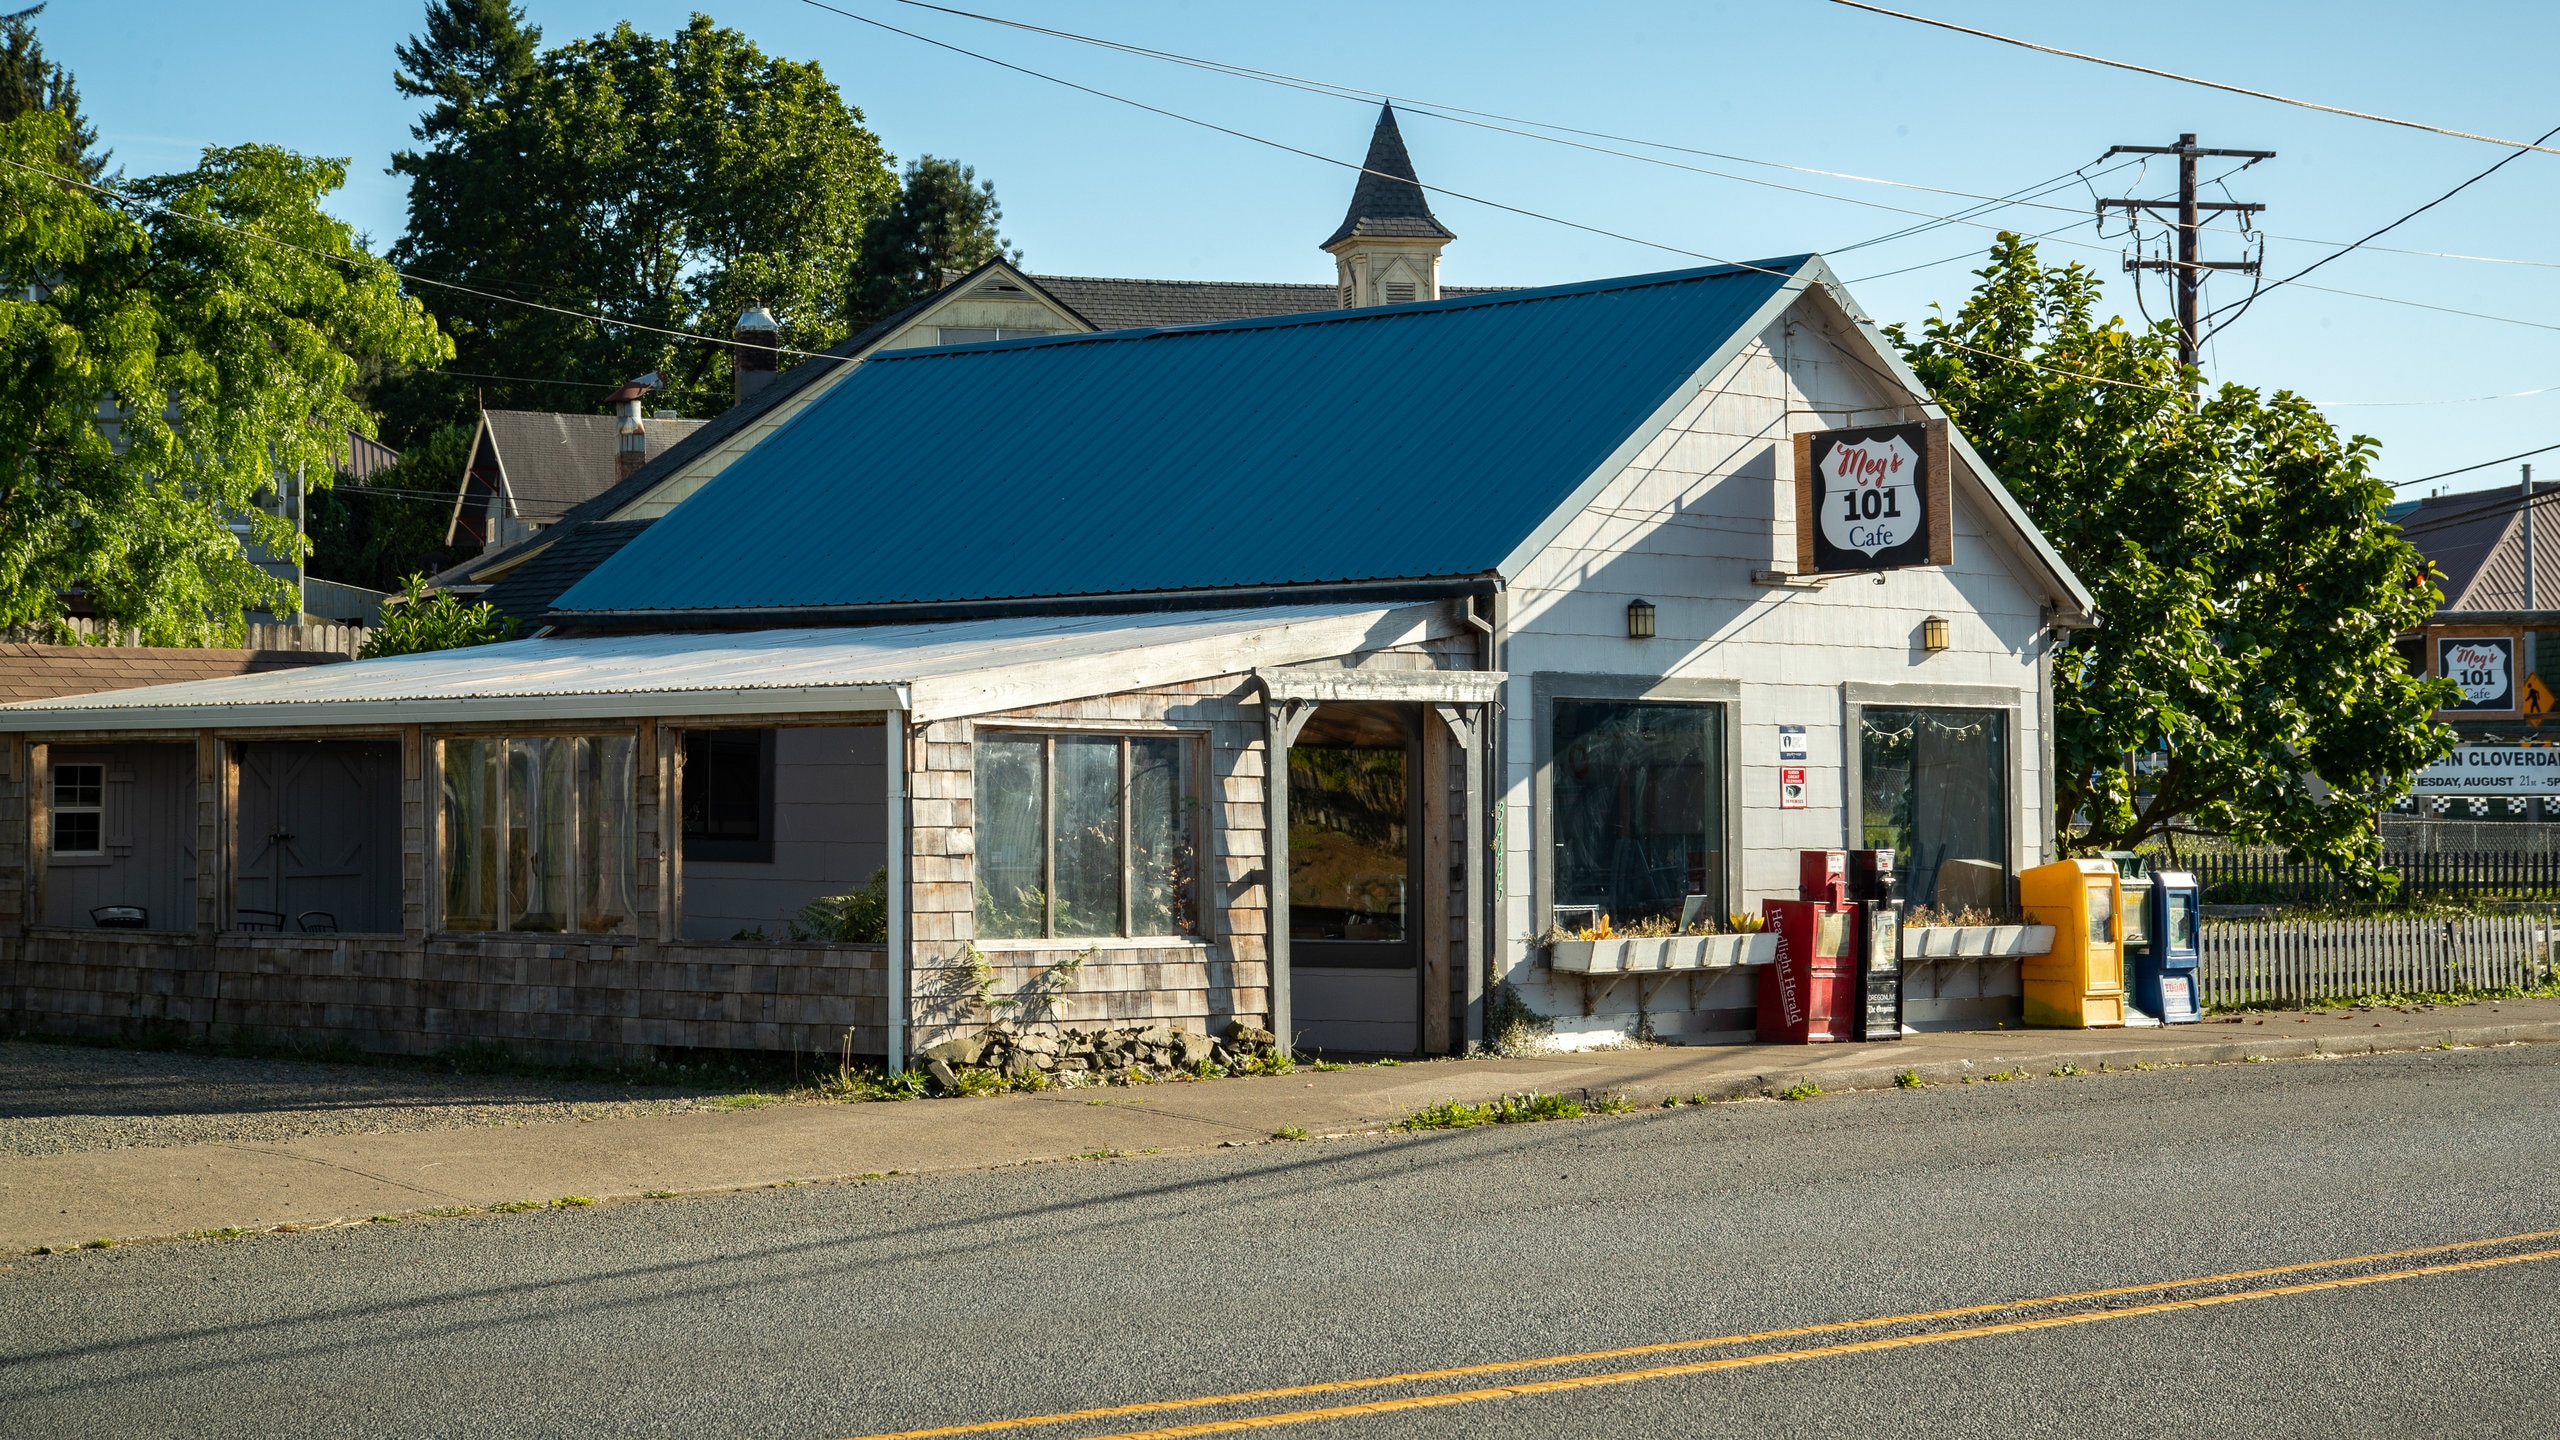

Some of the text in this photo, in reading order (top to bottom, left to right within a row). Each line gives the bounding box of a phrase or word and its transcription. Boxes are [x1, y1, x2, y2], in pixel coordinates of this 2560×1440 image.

[1837, 444, 1904, 488] Meg's
[1844, 488, 1901, 521] 101
[1849, 524, 1893, 547] Cafe
[2456, 646, 2497, 669] Meg's
[2460, 670, 2495, 685] 101
[2465, 688, 2490, 699] Cafe
[2469, 751, 2560, 766] CLOVERDA
[2463, 777, 2514, 787] AUGUST
[1495, 801, 1505, 903] 34445
[1771, 907, 1792, 975] Headlight
[1784, 977, 1803, 1024] Herald
